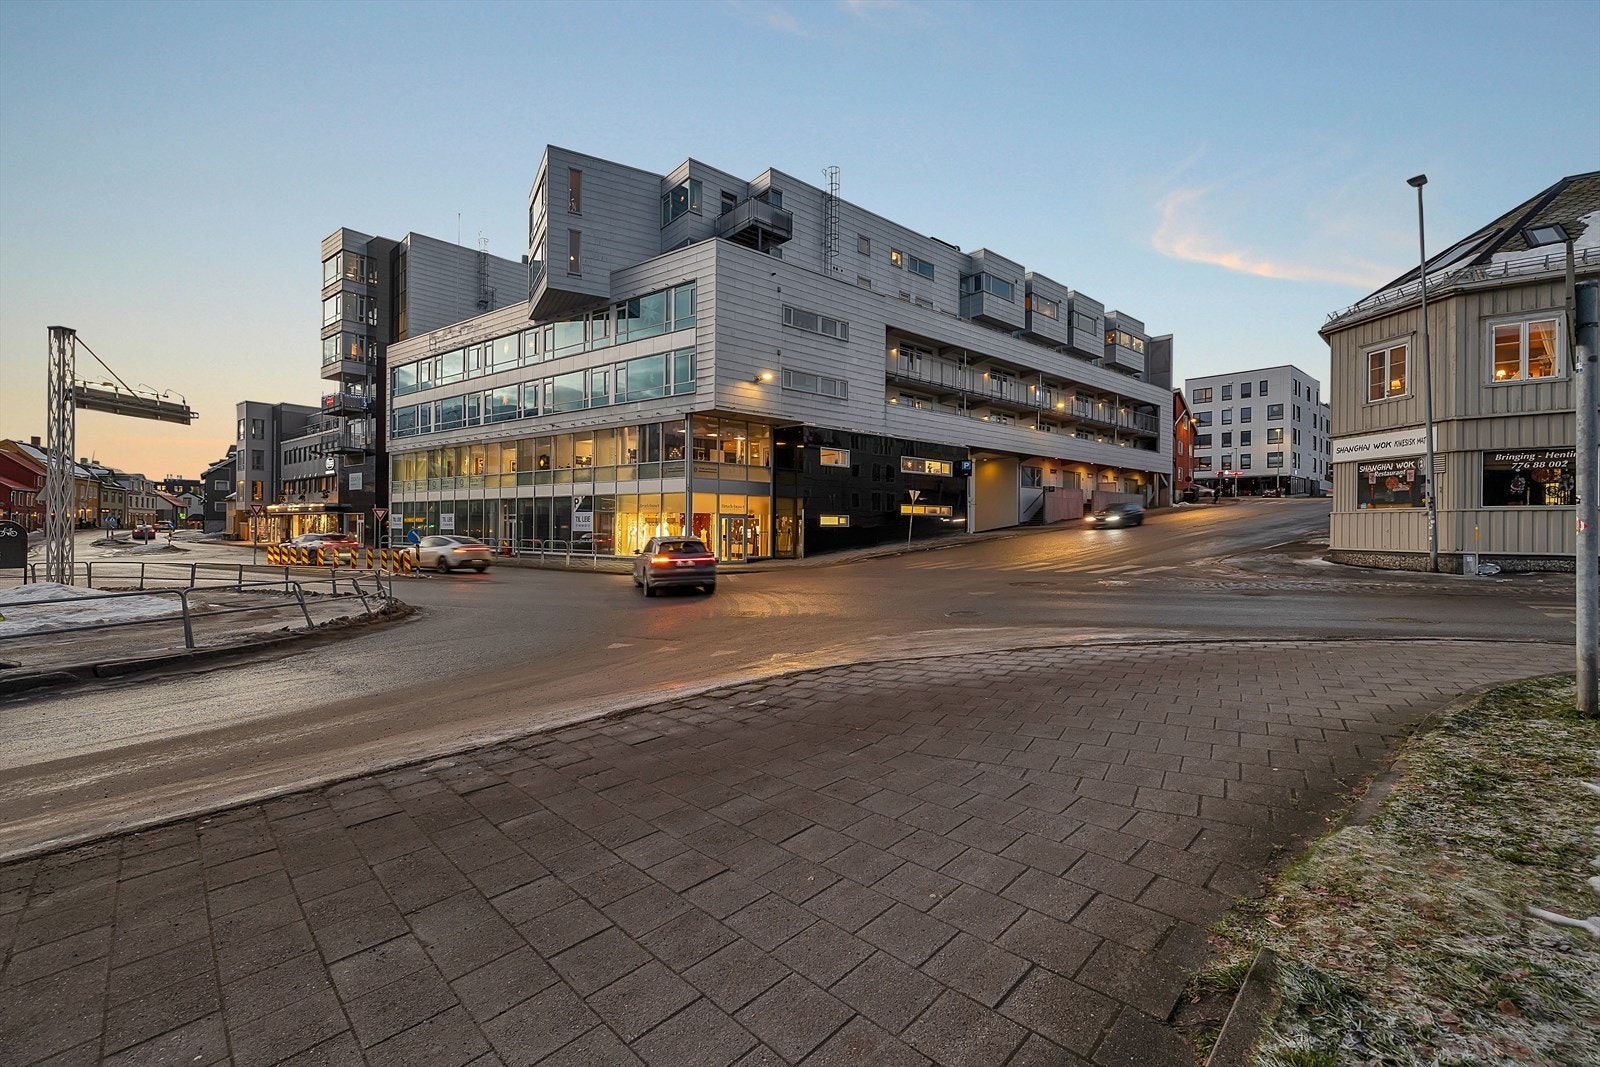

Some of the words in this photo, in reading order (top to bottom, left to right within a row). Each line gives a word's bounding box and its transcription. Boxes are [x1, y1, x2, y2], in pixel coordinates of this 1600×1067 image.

[1336, 444, 1370, 454] SHANGHAI
[1373, 441, 1391, 449] WOK
[1495, 453, 1535, 461] Bringing
[1359, 463, 1393, 473] SHANGHAI
[1396, 461, 1415, 469] WOK
[1548, 460, 1569, 468] 002
[1375, 469, 1406, 477] Restaurant
